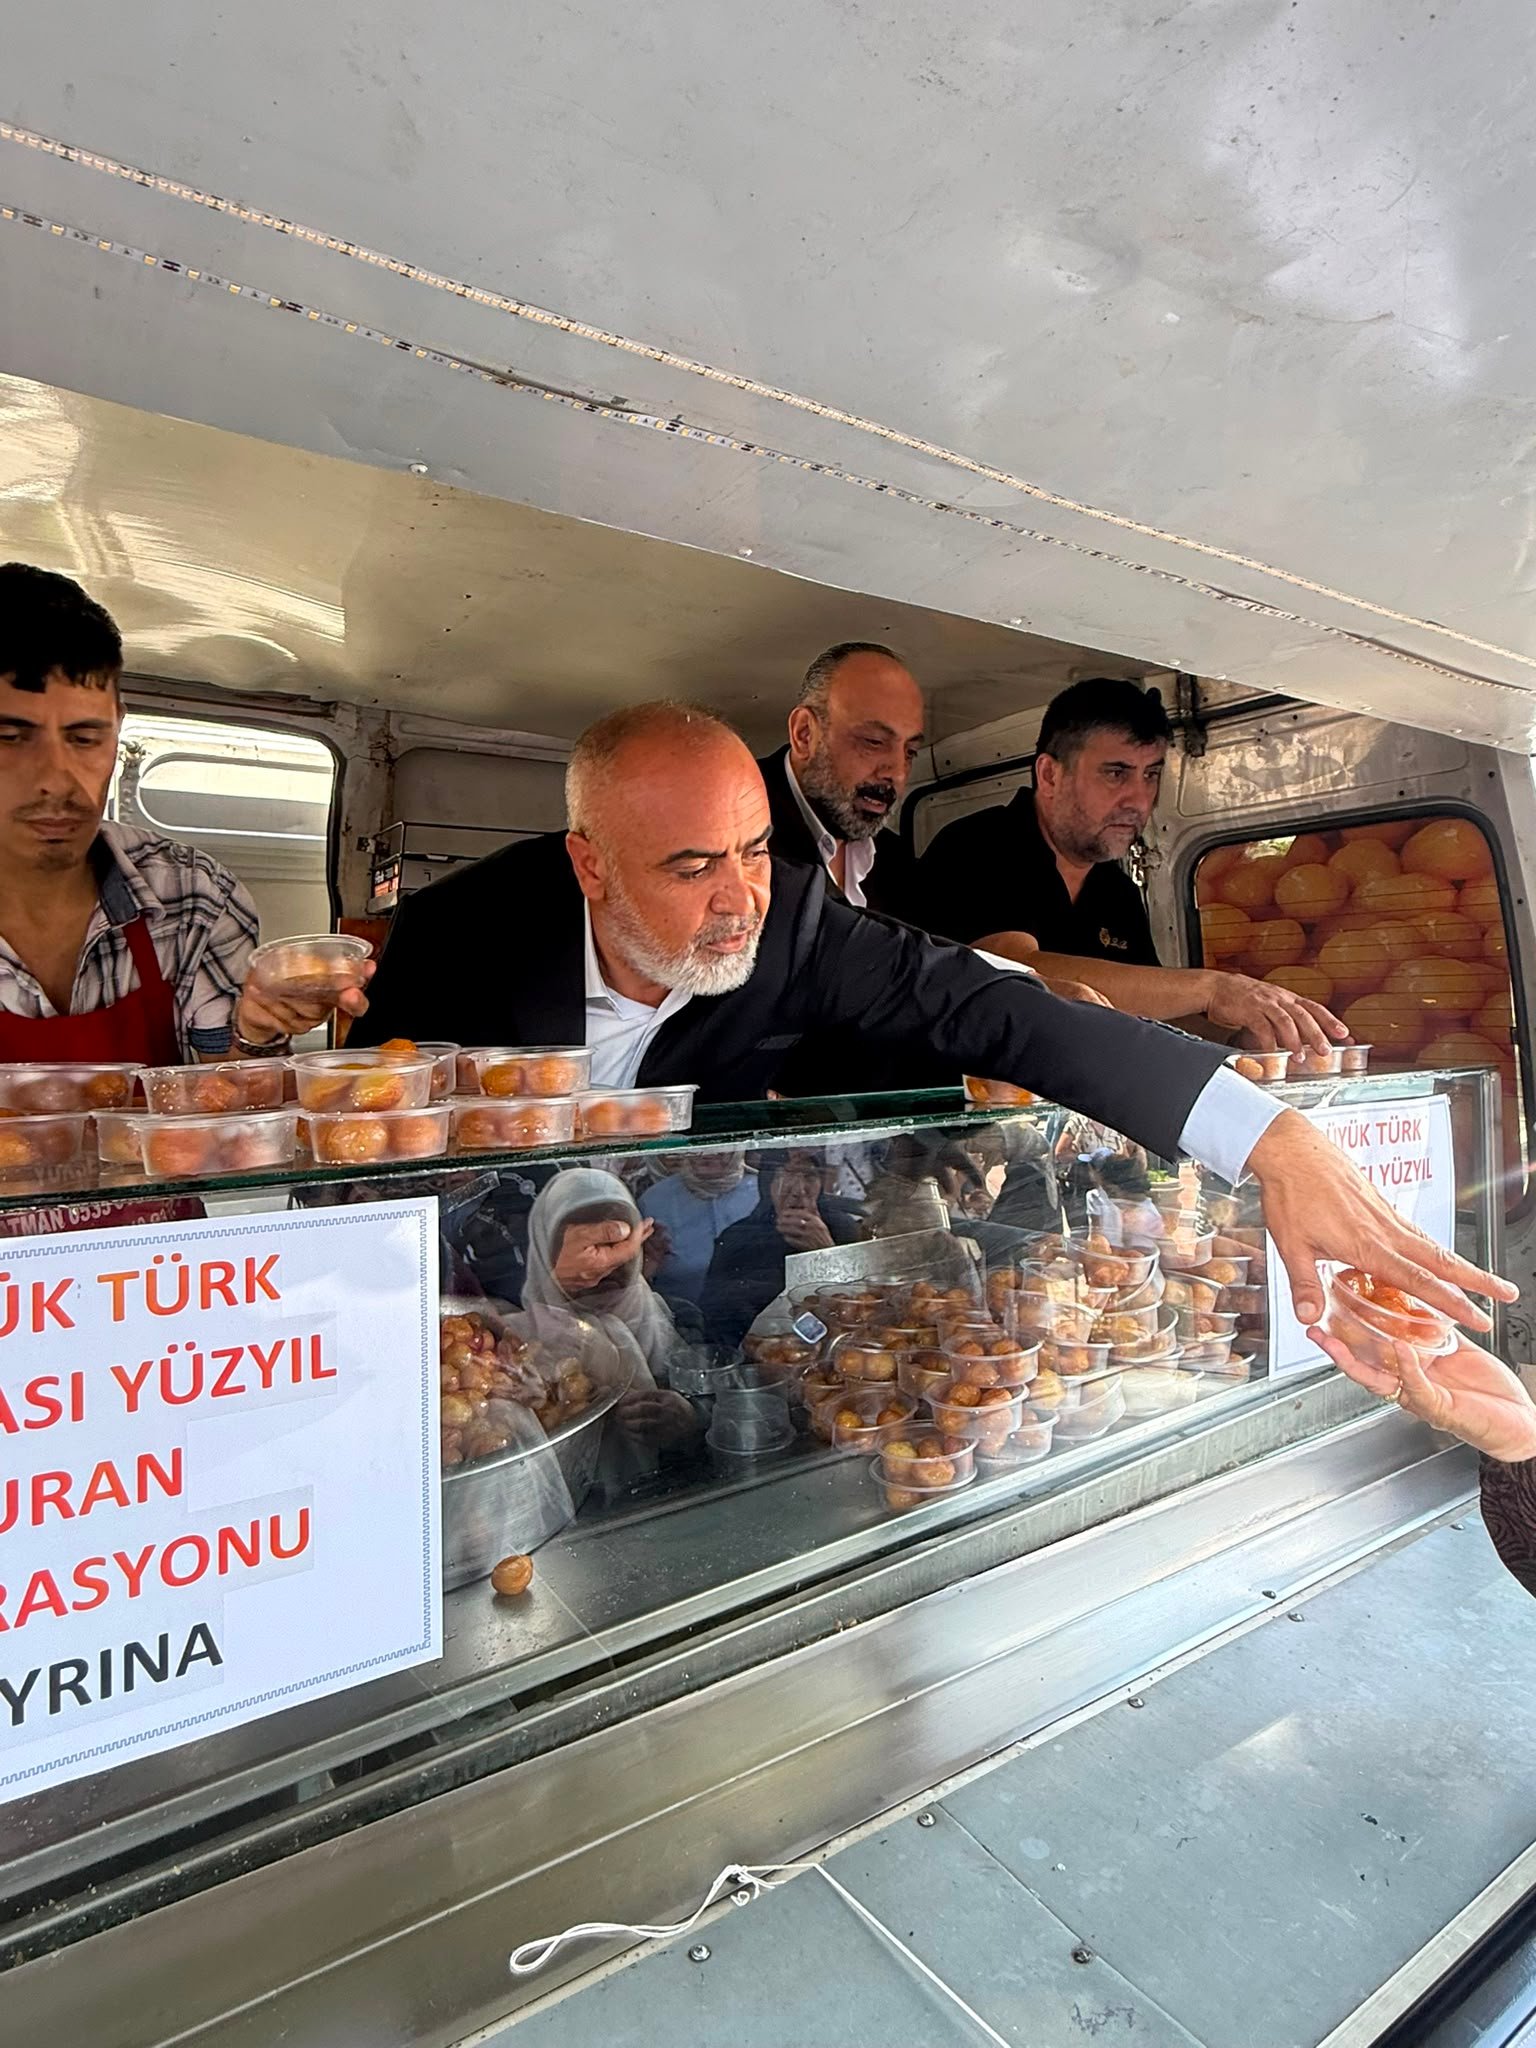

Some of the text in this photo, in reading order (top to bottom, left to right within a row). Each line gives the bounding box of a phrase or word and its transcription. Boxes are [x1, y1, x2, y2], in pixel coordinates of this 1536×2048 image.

[1375, 1115, 1422, 1145] TÜRK
[1379, 1156, 1433, 1187] YÜZYIL
[97, 1253, 281, 1322] TÜRK
[110, 1334, 337, 1413] YÜZYIL
[0, 1508, 311, 1633] ASYONU
[0, 1622, 223, 1726] YRINA
